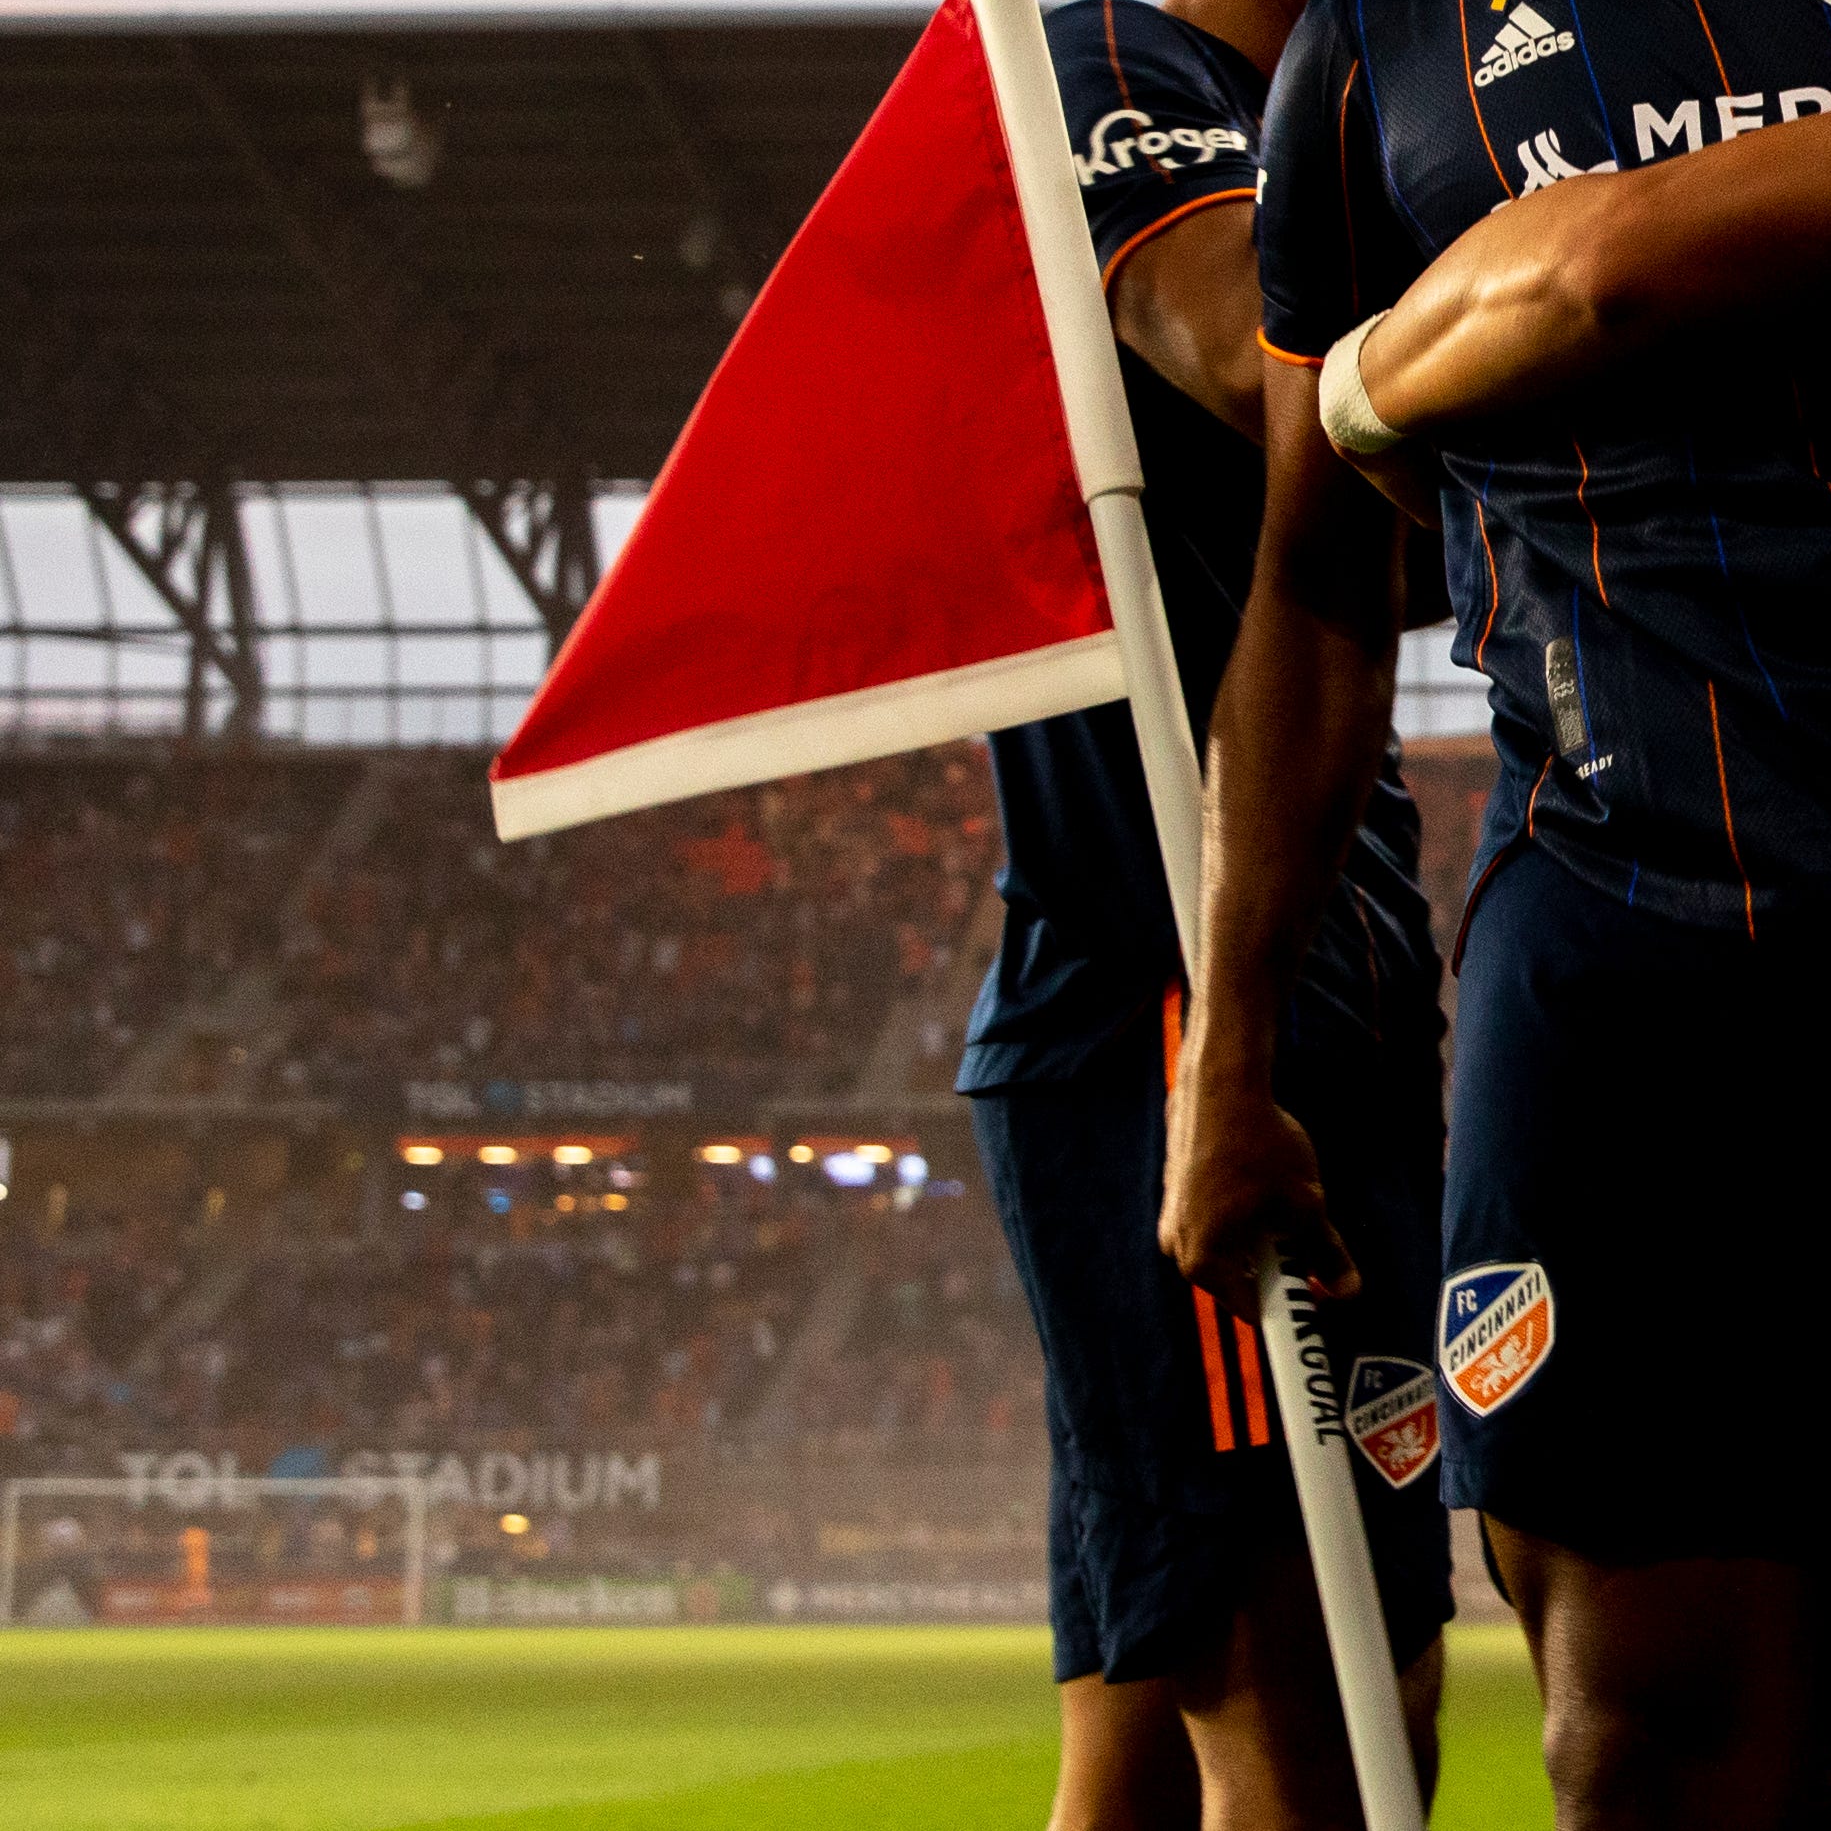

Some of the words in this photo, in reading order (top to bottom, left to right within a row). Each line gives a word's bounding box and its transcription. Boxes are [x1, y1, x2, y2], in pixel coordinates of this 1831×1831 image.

[1473, 30, 1576, 88] adidas
[1073, 108, 1248, 187] Kroger
[1450, 1270, 1542, 1371] CINCINNATI
[1455, 1287, 1478, 1318] FC
[339, 1449, 662, 1513] STADIUM
